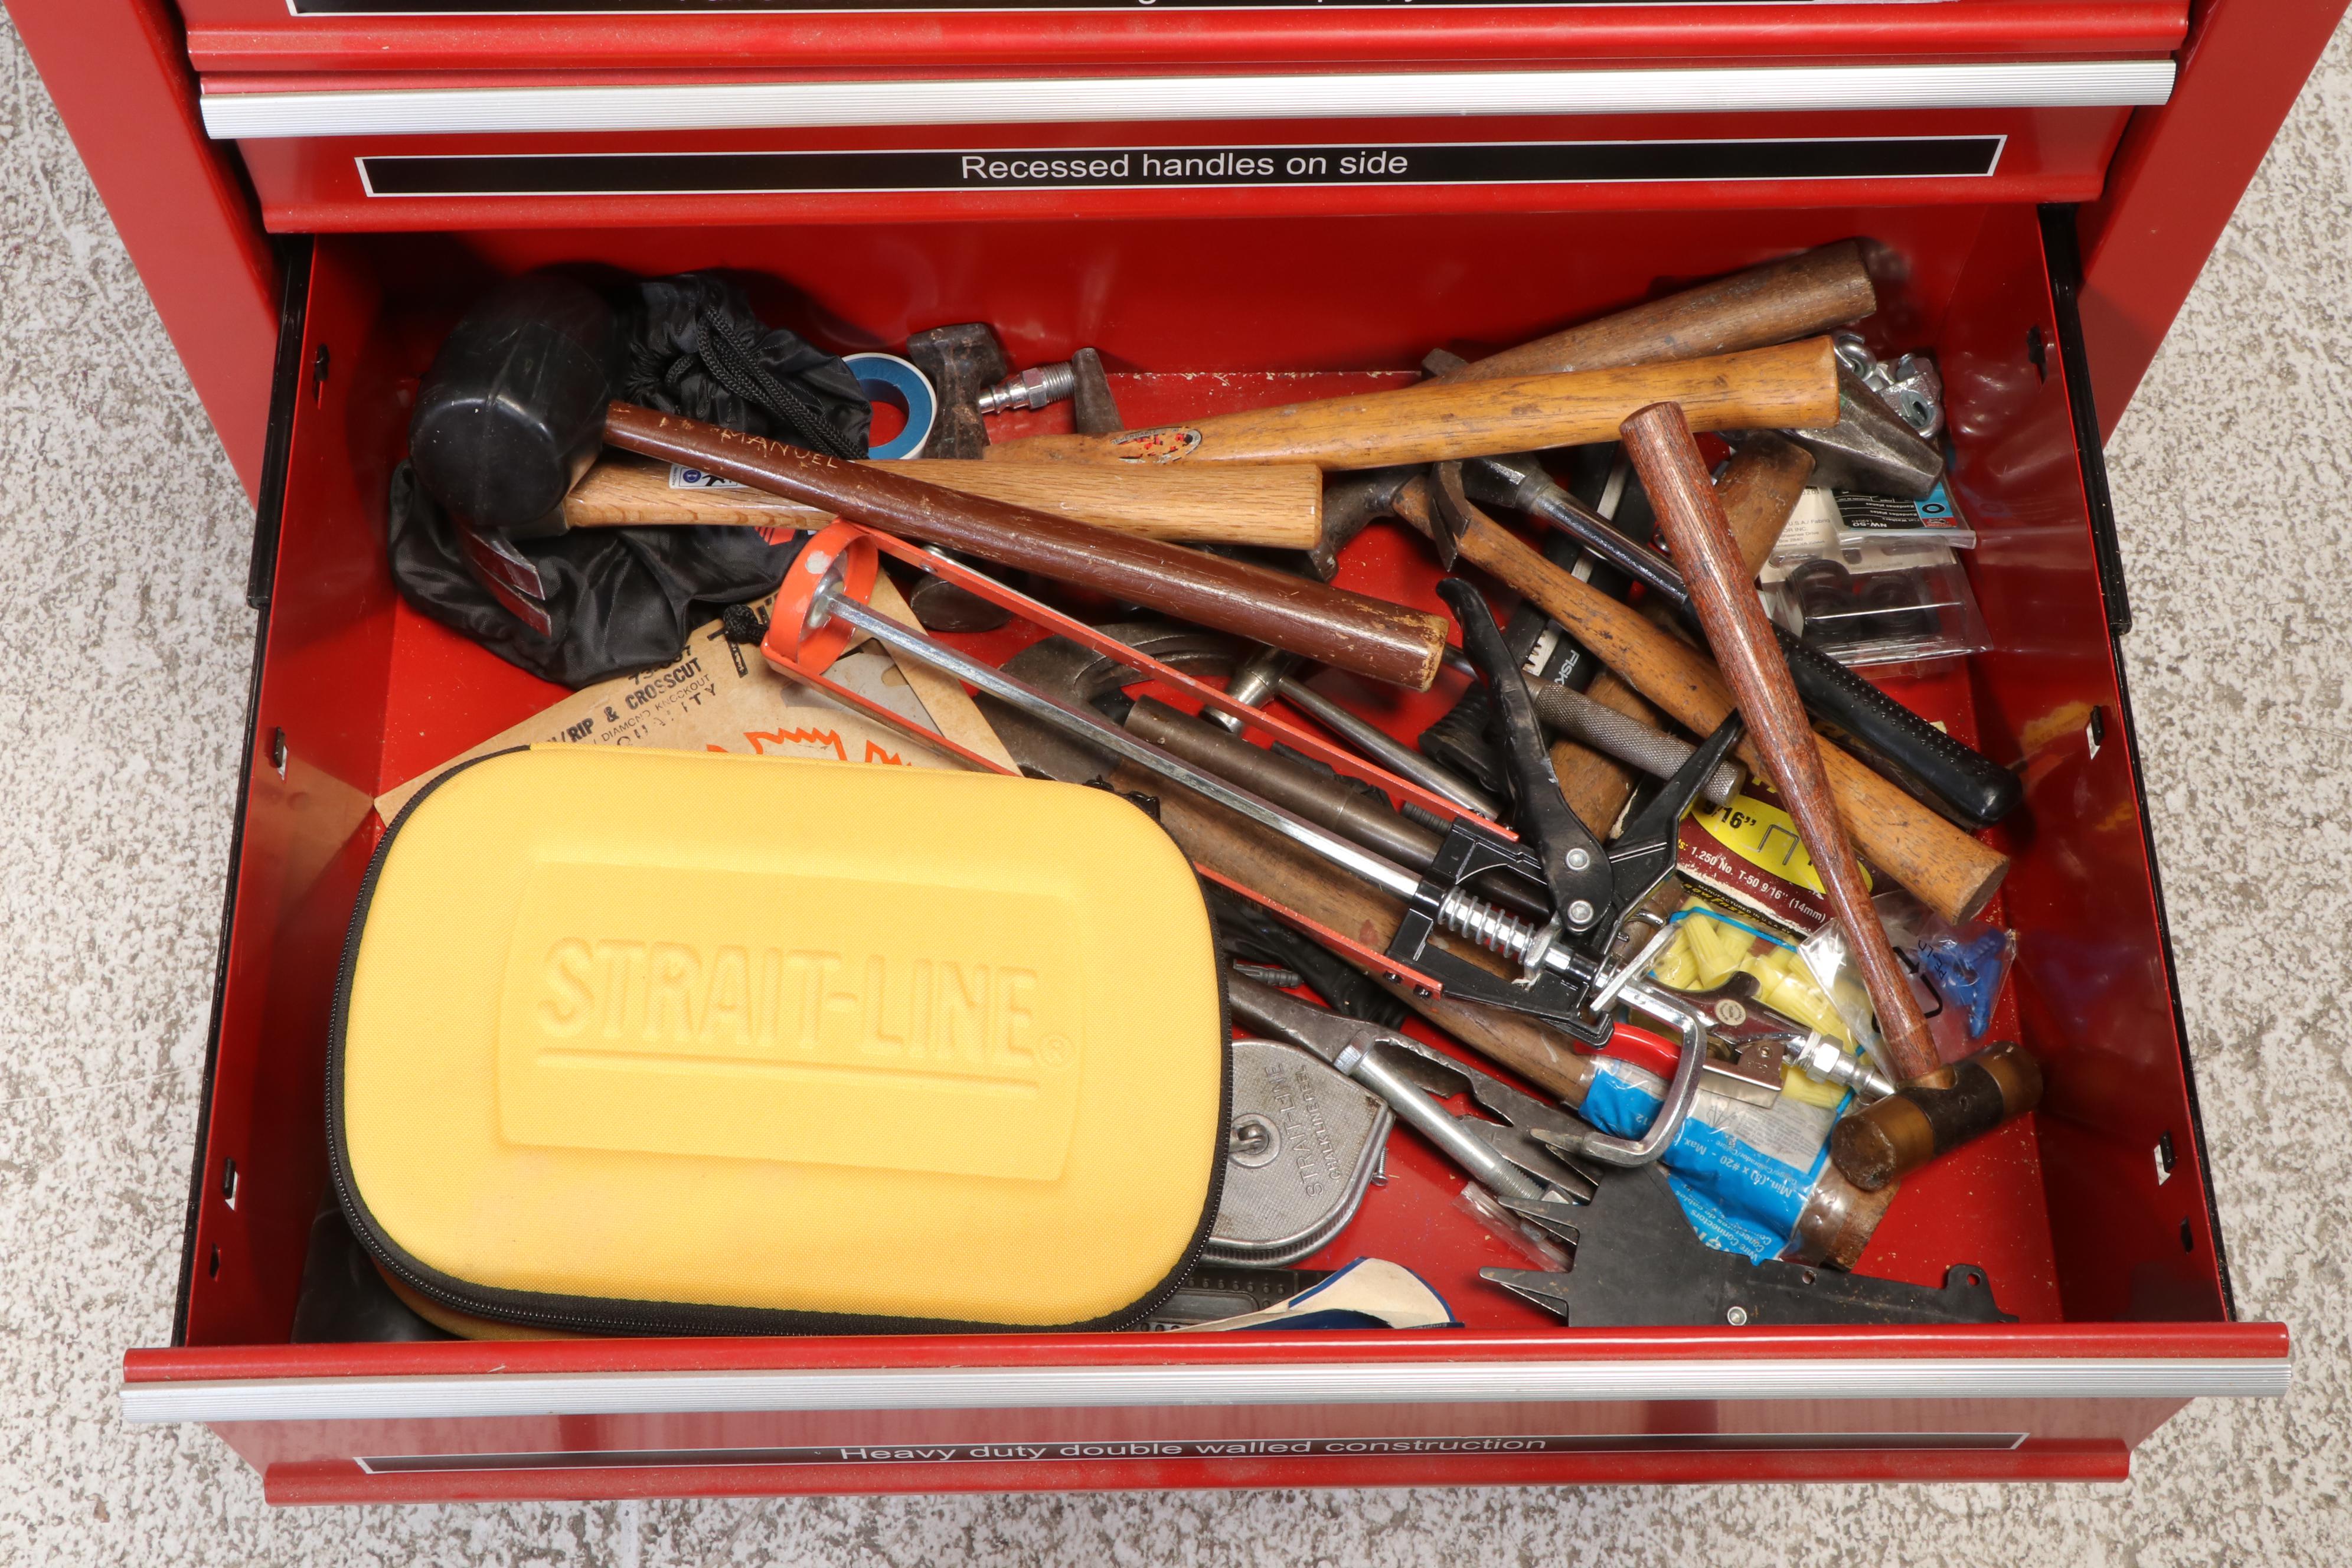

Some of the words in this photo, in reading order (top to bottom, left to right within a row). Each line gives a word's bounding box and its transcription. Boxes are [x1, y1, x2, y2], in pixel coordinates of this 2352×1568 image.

[961, 154, 1129, 179] Recessed
[1142, 152, 1274, 177] handles
[1285, 156, 1327, 176] on
[1338, 151, 1409, 175] side
[720, 429, 838, 468] MANUEL
[603, 706, 620, 723] &
[625, 657, 703, 710] CROSSCUT
[600, 710, 651, 741] DIAMOND
[1698, 884, 1752, 914] MANUFACTURED
[1719, 860, 1733, 876] No.
[1739, 870, 1760, 887] T-50
[1789, 897, 1826, 923] (14mm)
[537, 936, 1039, 1066] STRAIT-LINE
[1295, 1065, 1316, 1102] REEL
[1265, 1064, 1324, 1197] STRAIT-LINE
[1307, 1103, 1326, 1134] LINE
[1318, 1136, 1341, 1180] CHALK
[1684, 1137, 1708, 1156] Max.
[1719, 1155, 1741, 1172] #20
[1690, 1209, 1740, 1246] Connectors
[839, 1447, 956, 1461] Heavy
[969, 1445, 1047, 1460] duty
[1059, 1443, 1183, 1457] double
[1194, 1441, 1311, 1454] walled
[1325, 1438, 1546, 1453] construction
